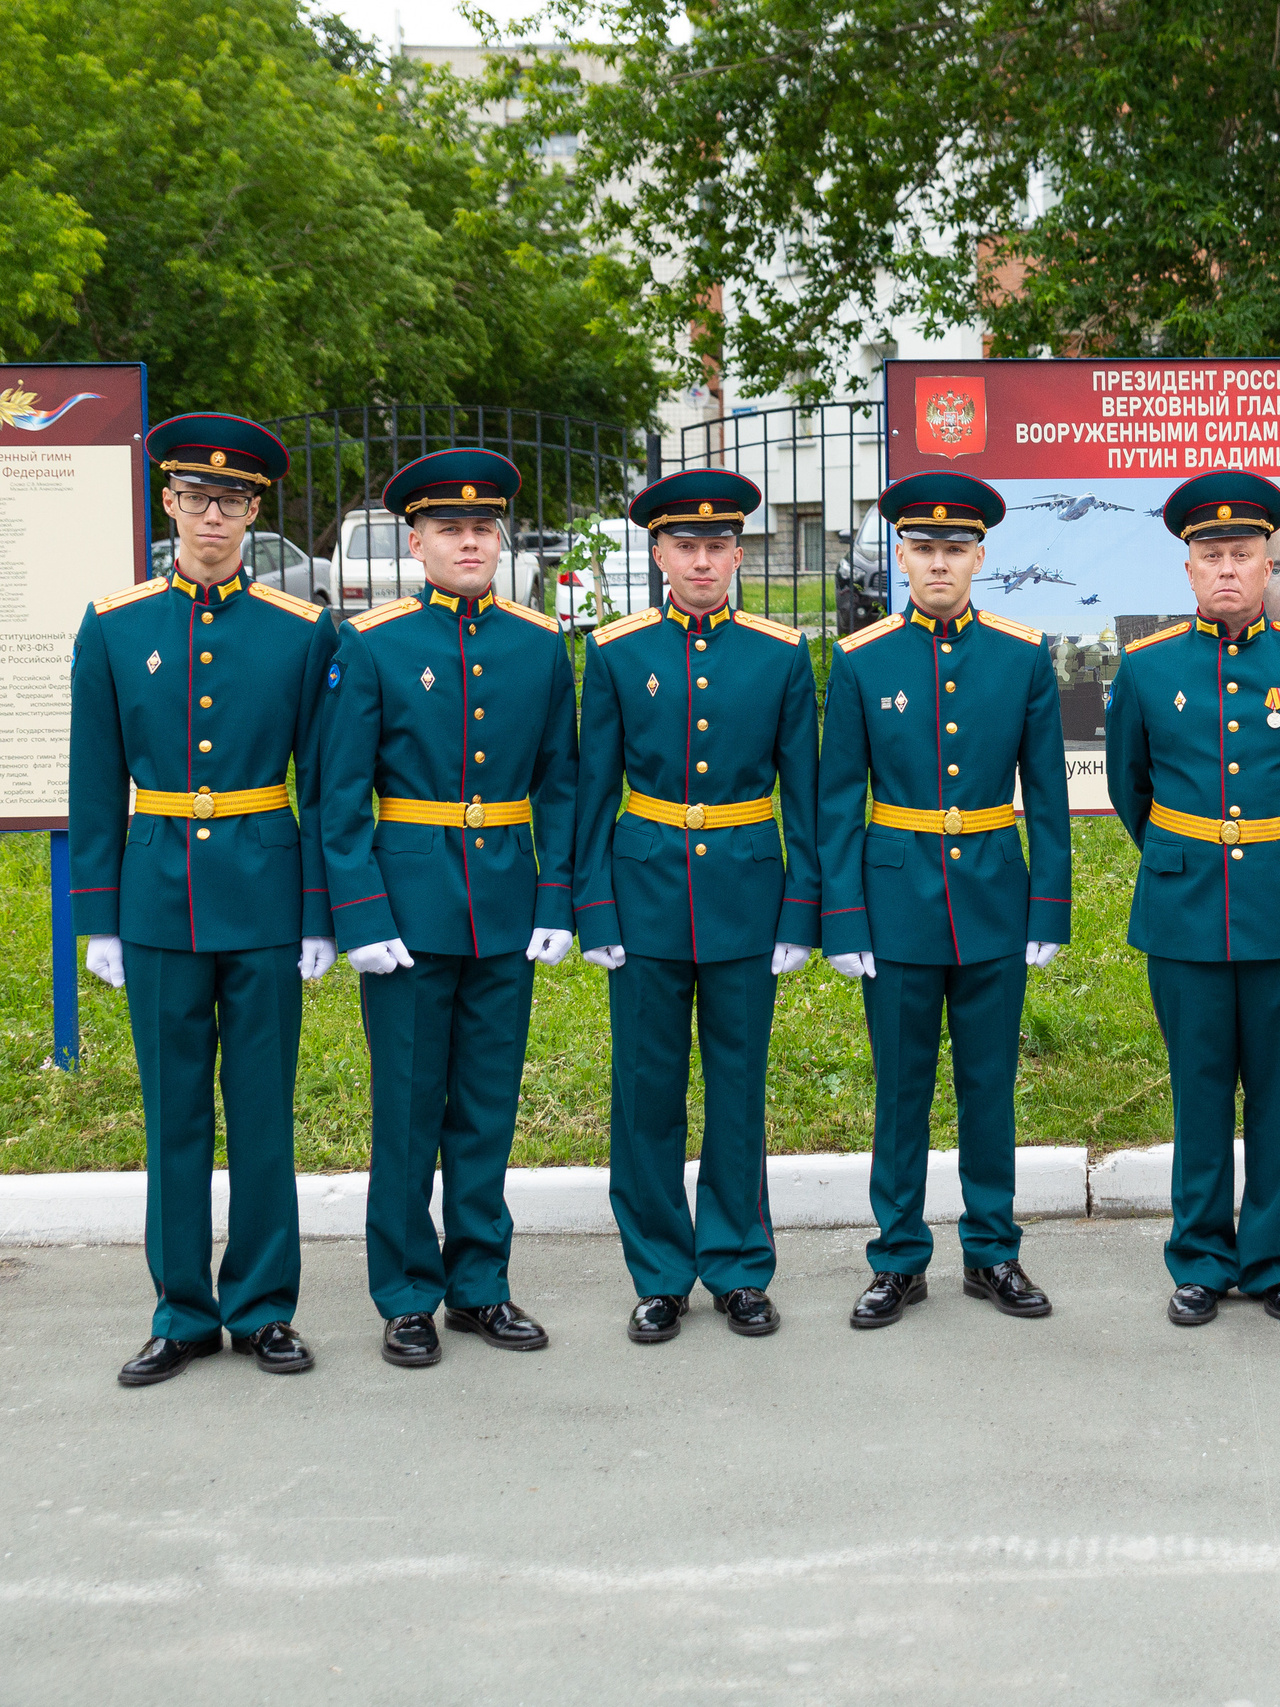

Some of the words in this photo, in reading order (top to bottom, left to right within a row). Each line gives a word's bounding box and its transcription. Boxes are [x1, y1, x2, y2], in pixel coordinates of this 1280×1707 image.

[1092, 369, 1218, 395] ПРЕЗИДЕНТ
[1102, 391, 1230, 417] ВЕРХОВНЫЙ
[1016, 422, 1199, 444] ВООРУЖЕННЫМИ
[41, 453, 72, 461] гимн
[1108, 447, 1177, 468] ПУТИН
[2, 466, 75, 480] Федерации
[8, 655, 62, 664] Российской
